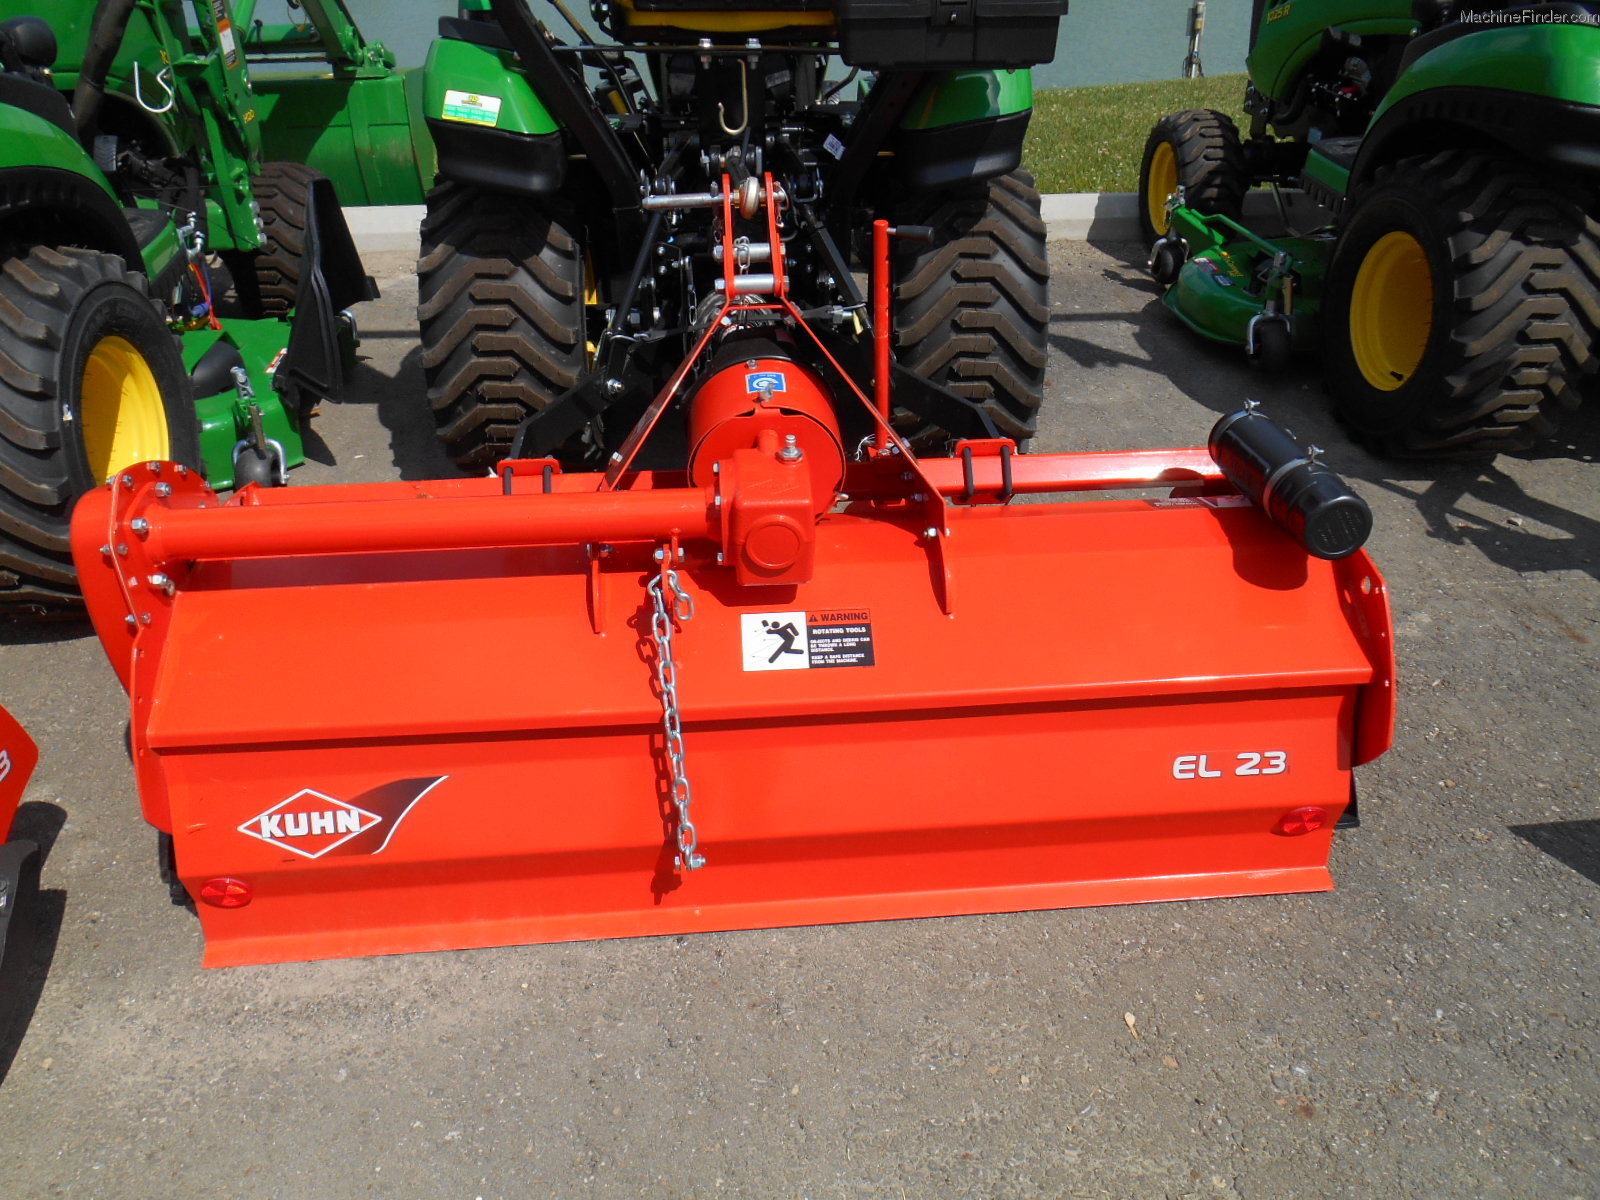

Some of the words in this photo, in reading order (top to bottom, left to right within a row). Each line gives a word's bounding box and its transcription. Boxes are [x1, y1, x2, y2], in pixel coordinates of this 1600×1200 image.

[820, 612, 868, 621] WARNING
[1172, 754, 1221, 779] EL
[1235, 751, 1287, 776] 23
[259, 808, 362, 838] KUHN
